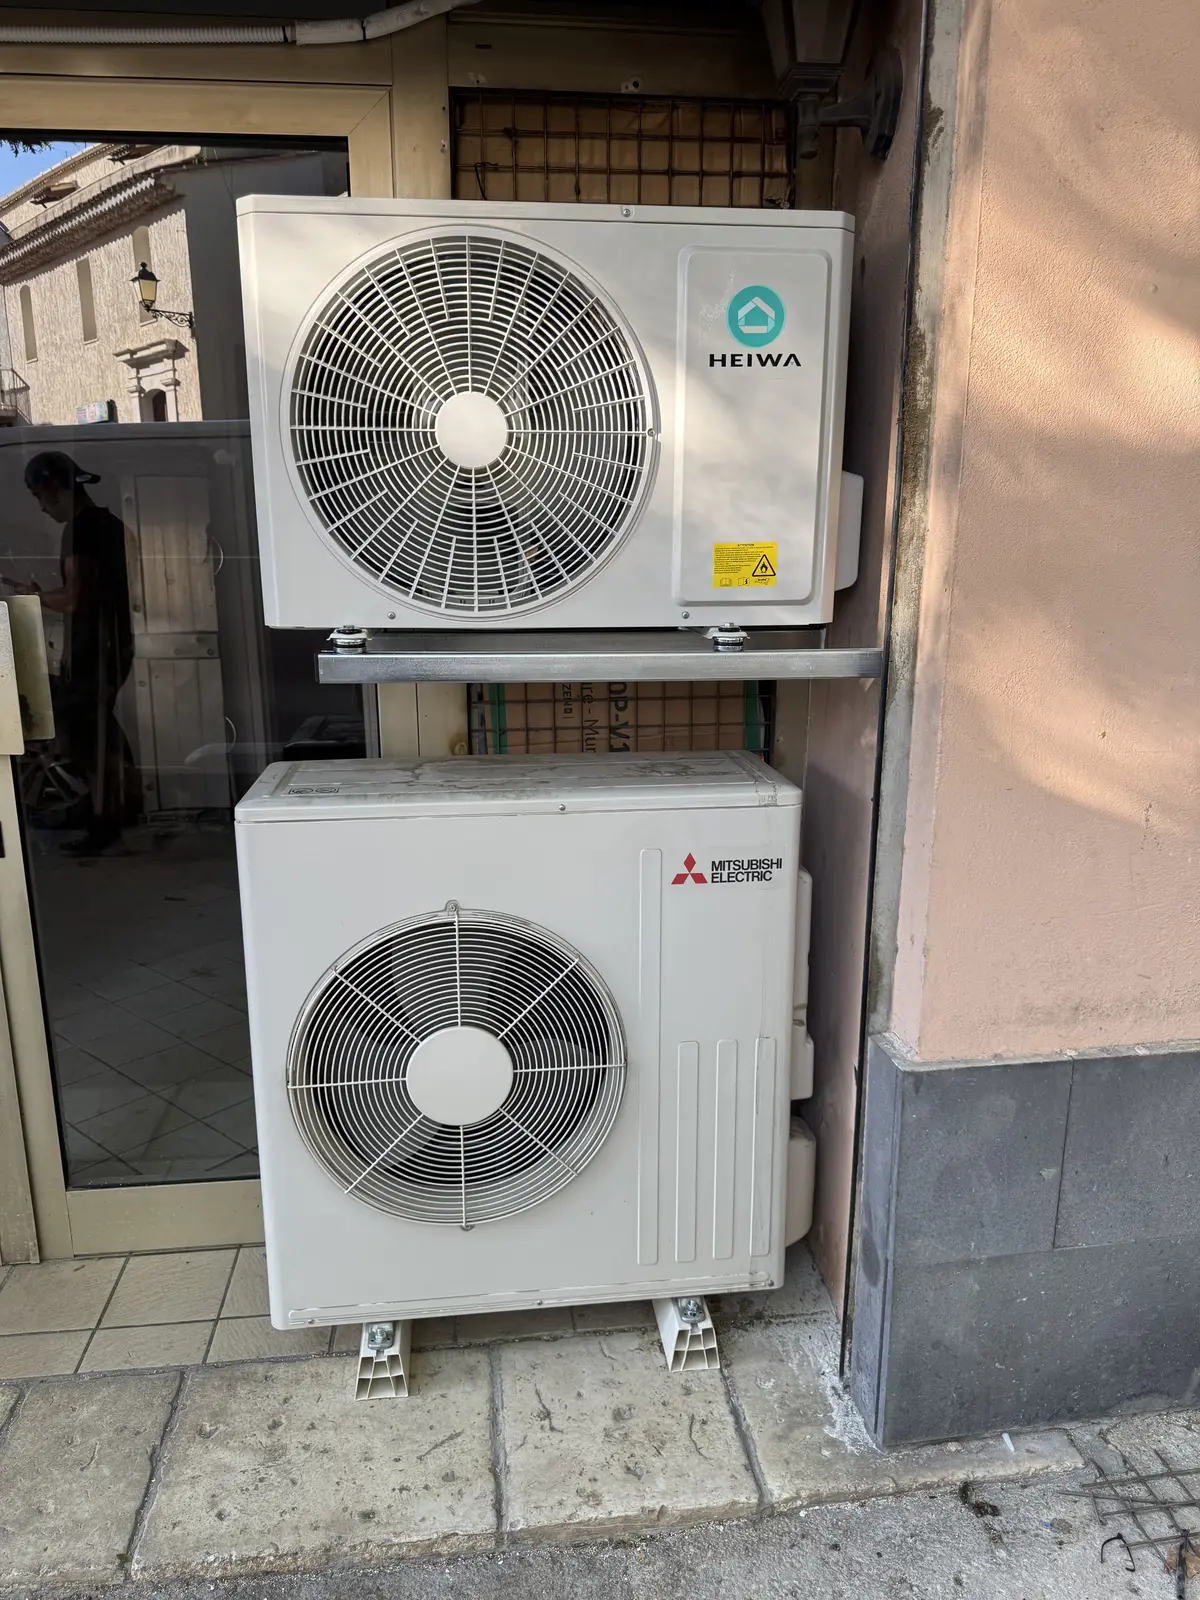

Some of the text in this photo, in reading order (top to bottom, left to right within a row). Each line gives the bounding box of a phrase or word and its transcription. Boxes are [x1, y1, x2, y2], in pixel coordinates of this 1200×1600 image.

[709, 353, 802, 368] HEIWA
[711, 858, 783, 872] MITSUBISHI
[711, 870, 773, 884] ELECTRIC
